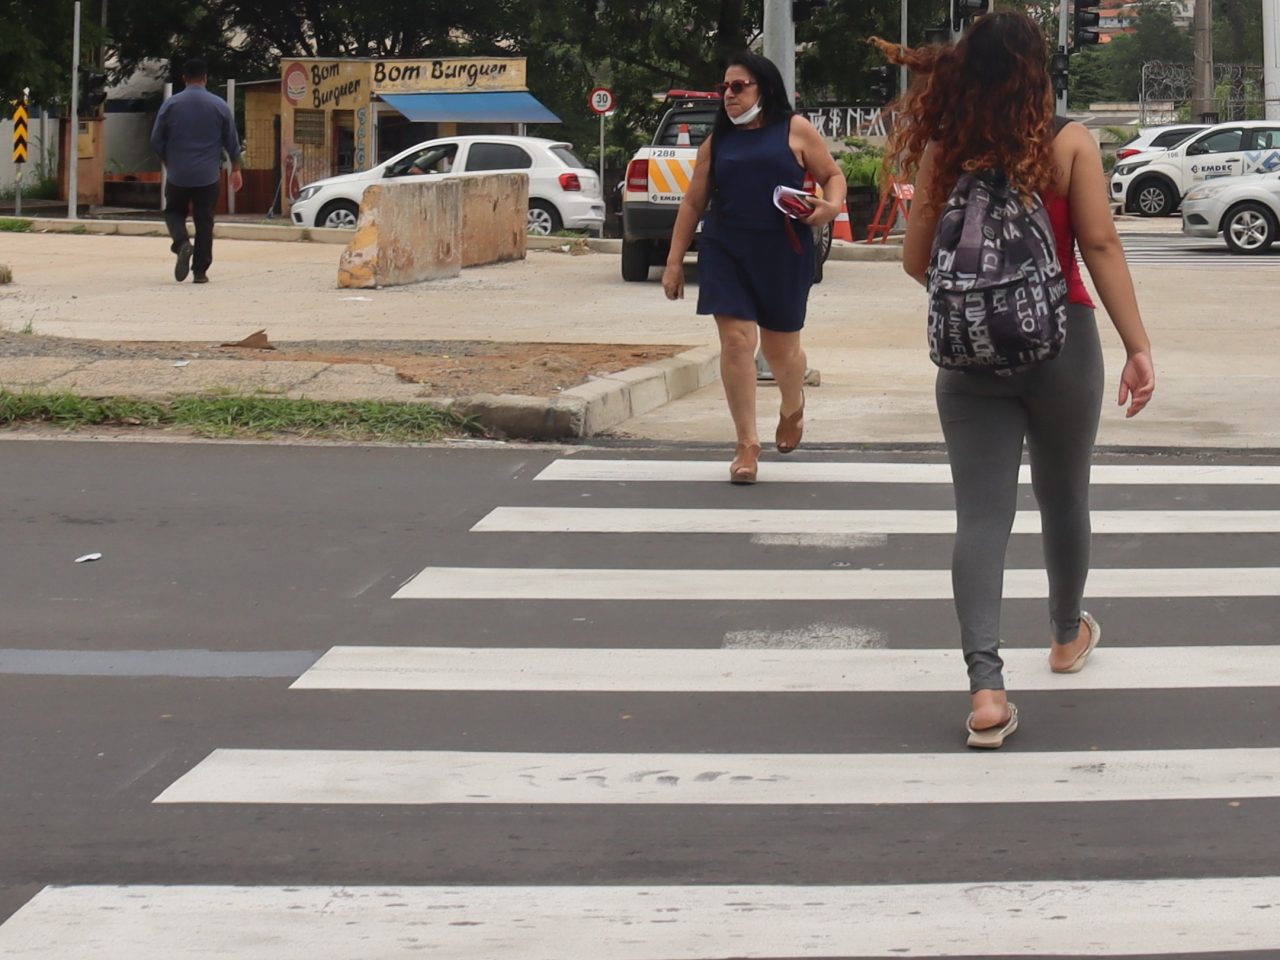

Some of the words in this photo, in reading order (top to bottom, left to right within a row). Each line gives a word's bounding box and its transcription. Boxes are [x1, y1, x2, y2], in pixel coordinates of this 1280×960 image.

[311, 63, 340, 86] Bom
[374, 62, 421, 83] Bom
[312, 77, 361, 109] Burguer
[596, 93, 609, 104] 30
[1201, 164, 1233, 173] EMDEC
